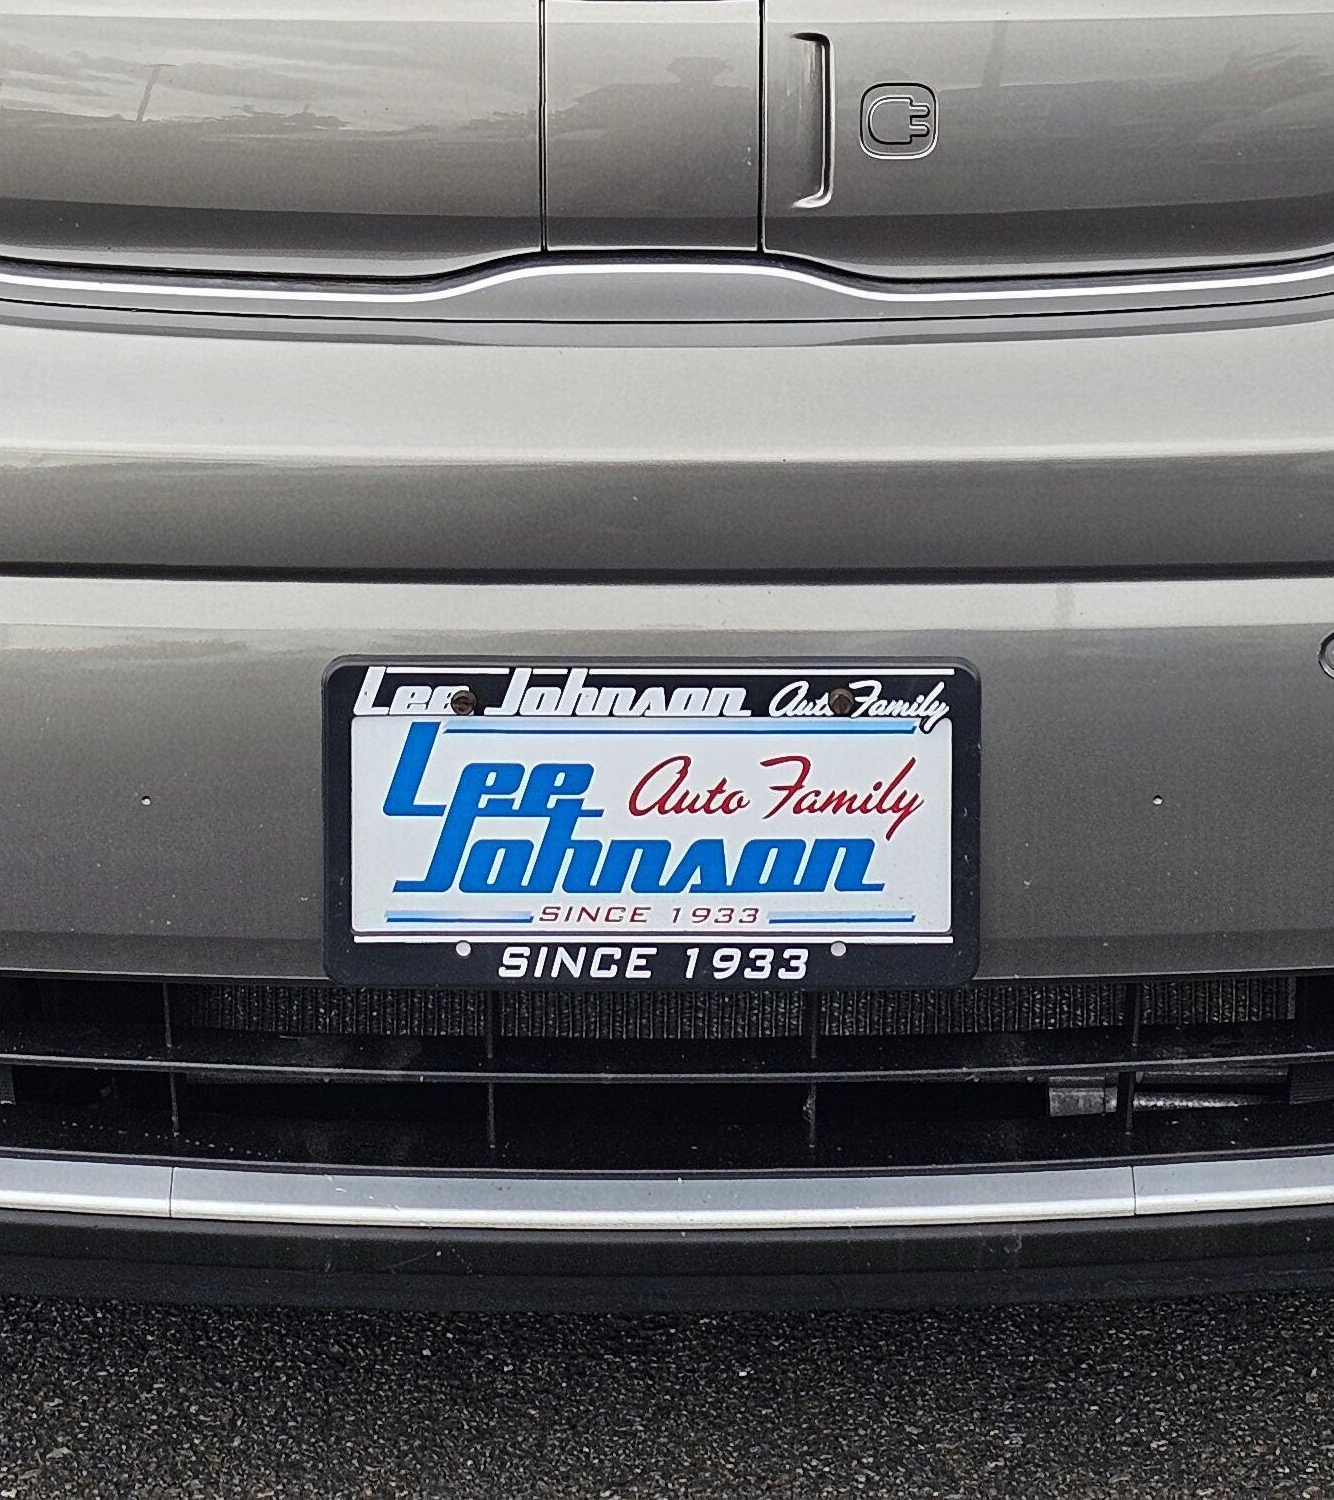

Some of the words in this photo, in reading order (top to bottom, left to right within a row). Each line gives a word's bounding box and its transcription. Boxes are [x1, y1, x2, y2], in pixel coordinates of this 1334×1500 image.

[353, 666, 474, 716] Lee
[484, 667, 752, 717] Johnson
[768, 680, 837, 718] Aut
[848, 680, 950, 733] Family
[382, 721, 604, 818] Lee
[627, 755, 751, 818] Auto
[759, 755, 926, 841] Family
[391, 812, 886, 894] Johnson
[538, 906, 650, 925] SINCE
[670, 906, 761, 925] 1933
[497, 947, 659, 980] SINCE
[682, 947, 811, 980] 1933
